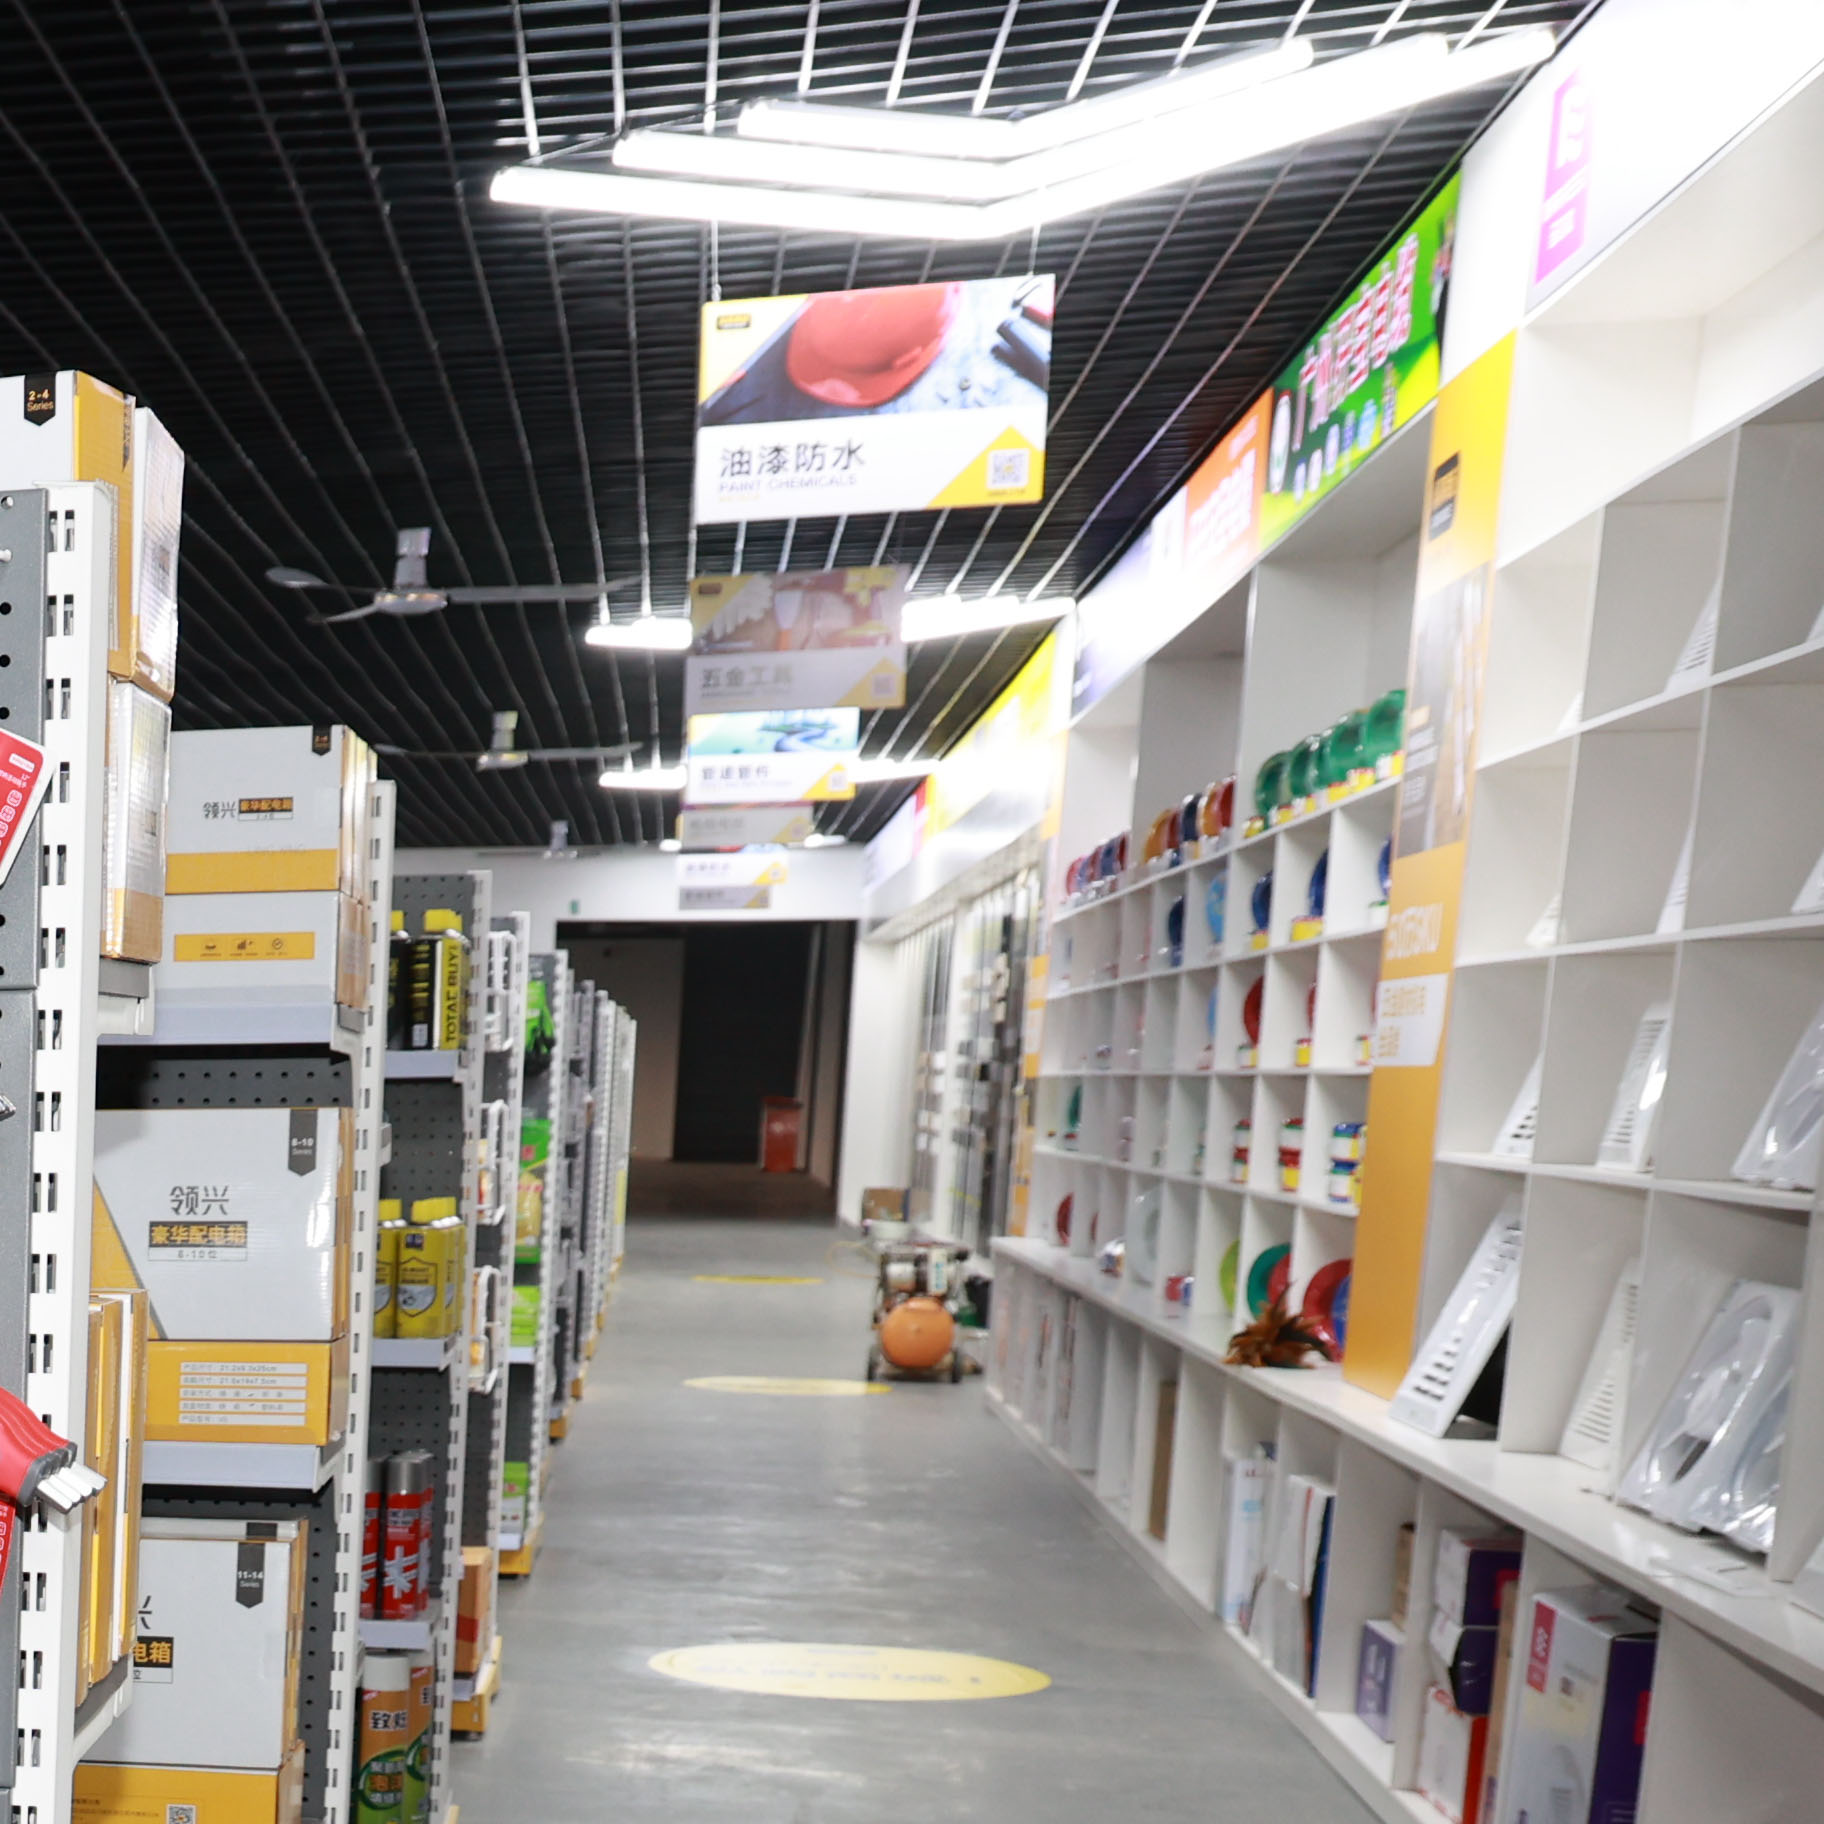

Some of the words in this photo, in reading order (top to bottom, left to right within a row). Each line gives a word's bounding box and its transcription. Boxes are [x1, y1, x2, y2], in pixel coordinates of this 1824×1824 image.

[27, 389, 50, 401] 2-4
[26, 400, 54, 412] Series
[719, 440, 866, 478] 油漆防水
[170, 1185, 229, 1215] 领兴
[151, 1225, 247, 1246] 豪华配电箱
